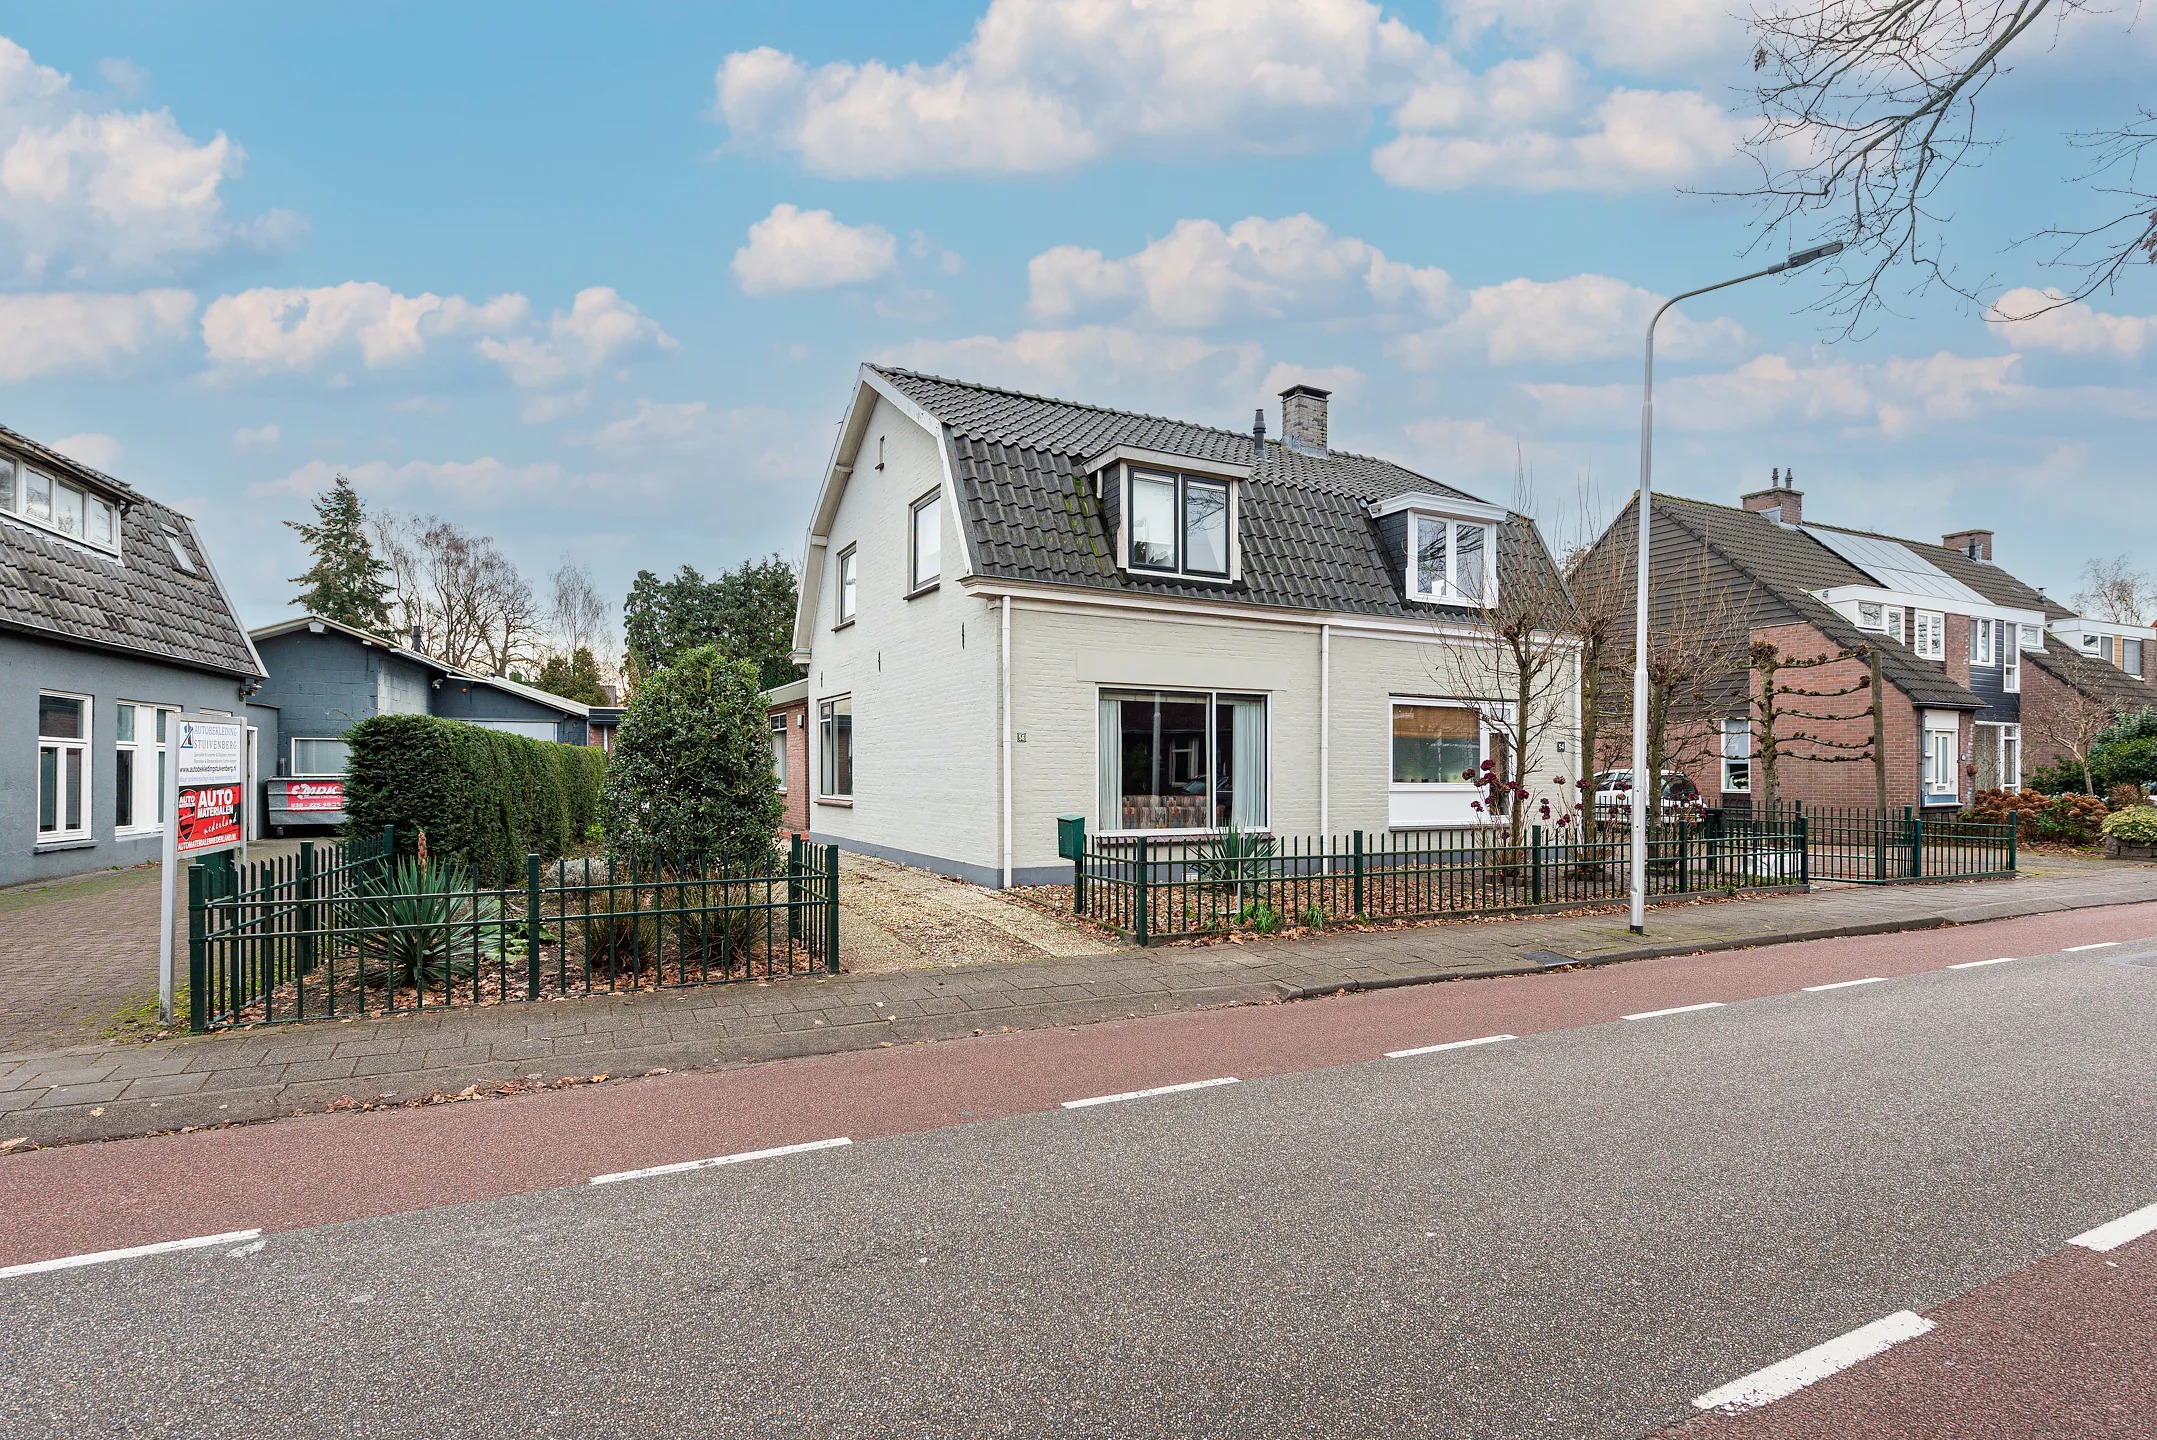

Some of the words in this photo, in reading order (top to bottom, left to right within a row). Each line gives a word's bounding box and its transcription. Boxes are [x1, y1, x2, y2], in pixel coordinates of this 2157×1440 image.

[194, 726, 237, 736] AUTOBEKLEDING
[194, 740, 237, 749] STUIVENBERG
[179, 795, 195, 804] AUTO
[198, 789, 233, 808] AUTO
[197, 804, 234, 819] MATERIALEN
[203, 812, 237, 835] nederland
